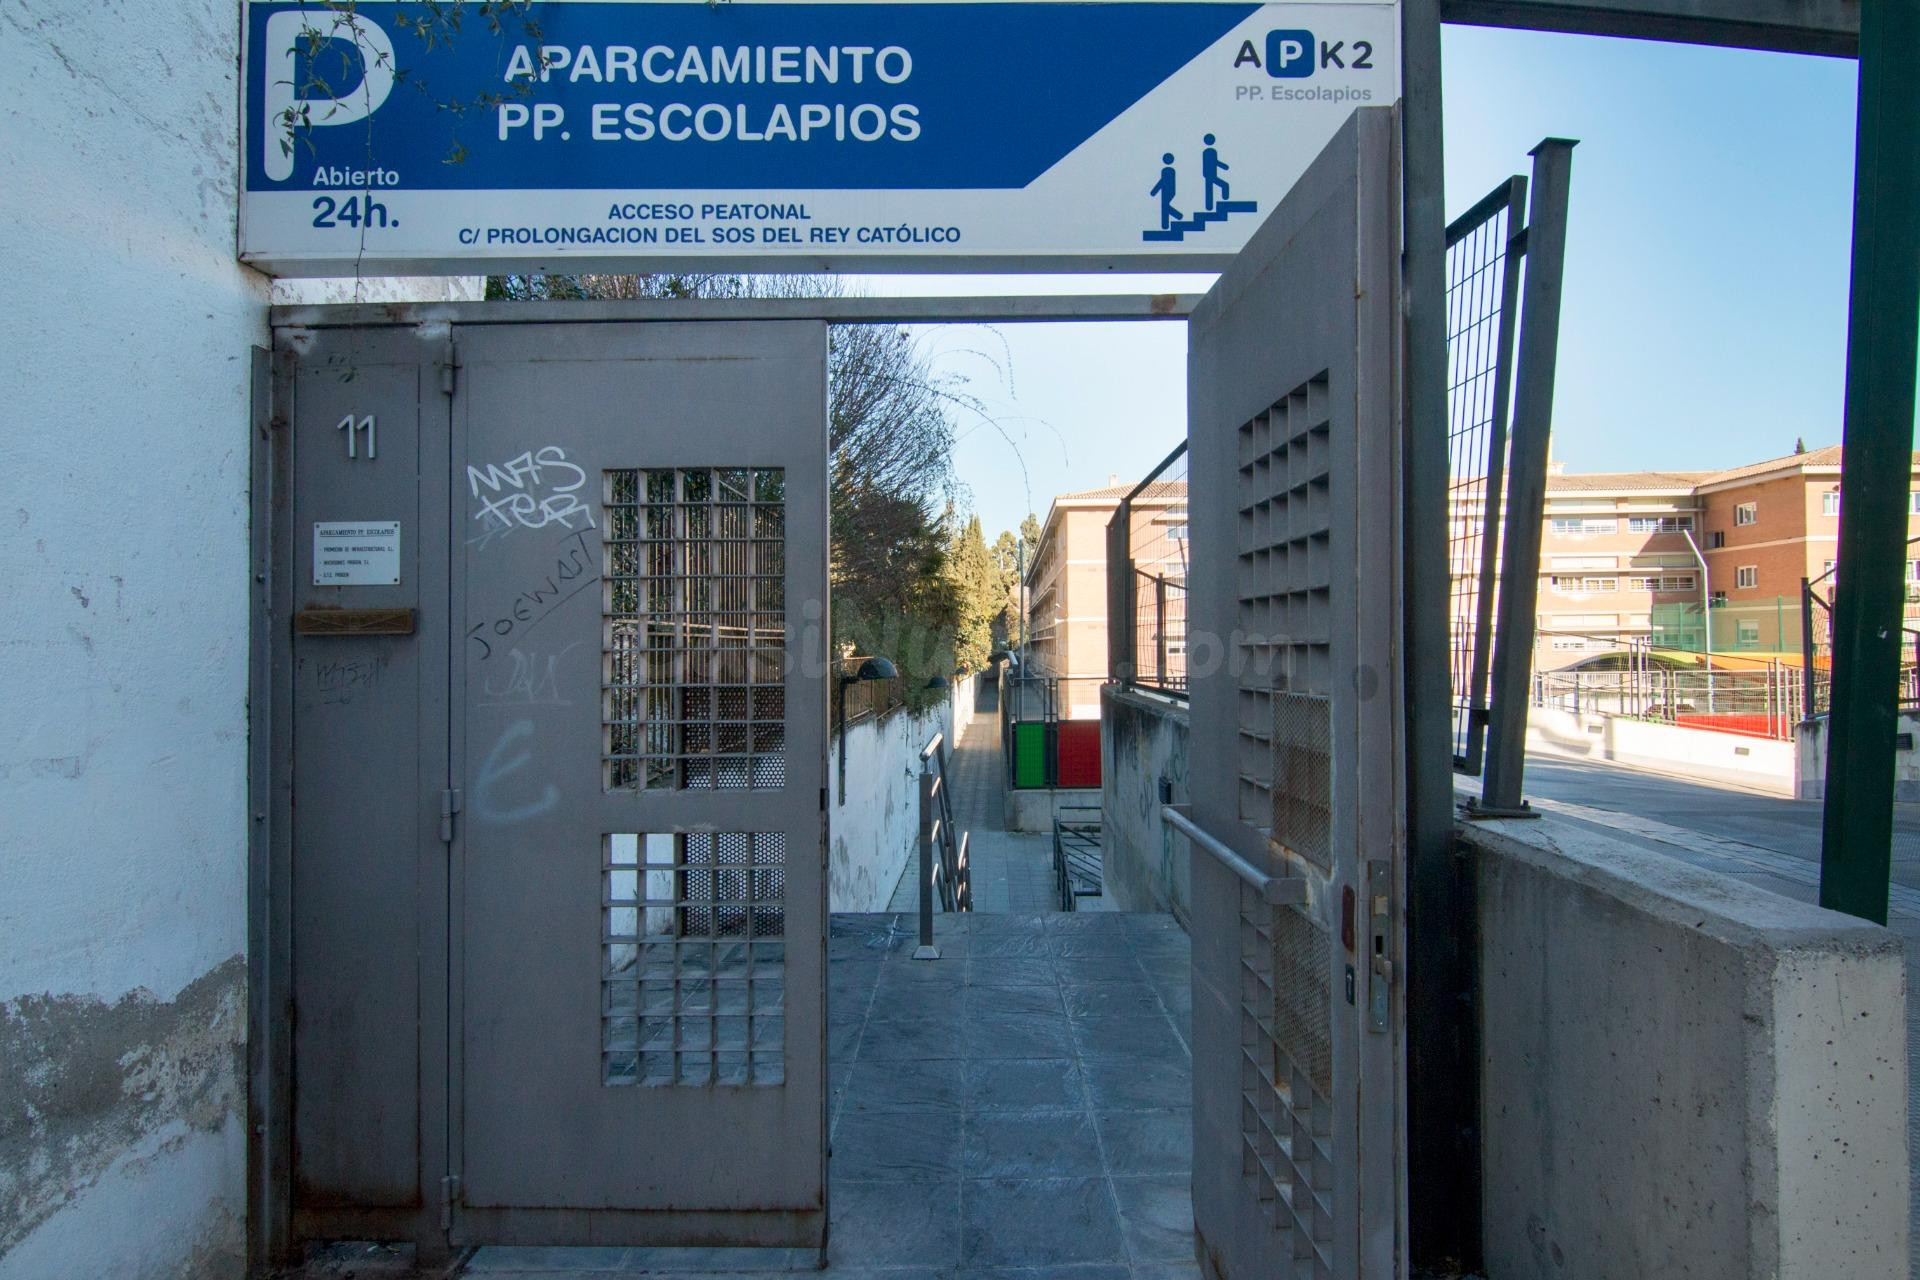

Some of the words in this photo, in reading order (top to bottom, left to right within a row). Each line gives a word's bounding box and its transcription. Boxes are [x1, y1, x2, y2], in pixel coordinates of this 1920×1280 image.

[503, 44, 913, 84] APARCAMIENTO
[264, 10, 396, 182] P
[1235, 85, 1264, 101] PP.
[1271, 85, 1372, 104] Escolapios
[498, 103, 571, 142] PP.
[591, 102, 922, 142] ESCOLAPIOS
[312, 165, 400, 187] Abierto
[311, 194, 400, 229] 24h.
[608, 203, 695, 221] ACCESO
[701, 203, 812, 220] PEATONAL
[458, 227, 481, 245] C/
[487, 226, 658, 244] PROLONGACION
[665, 227, 706, 243] DEL
[712, 226, 756, 244] SOS
[762, 227, 803, 243] DEL
[810, 227, 851, 243] REY
[856, 223, 962, 244] CATÓLICO
[337, 413, 377, 459] 11
